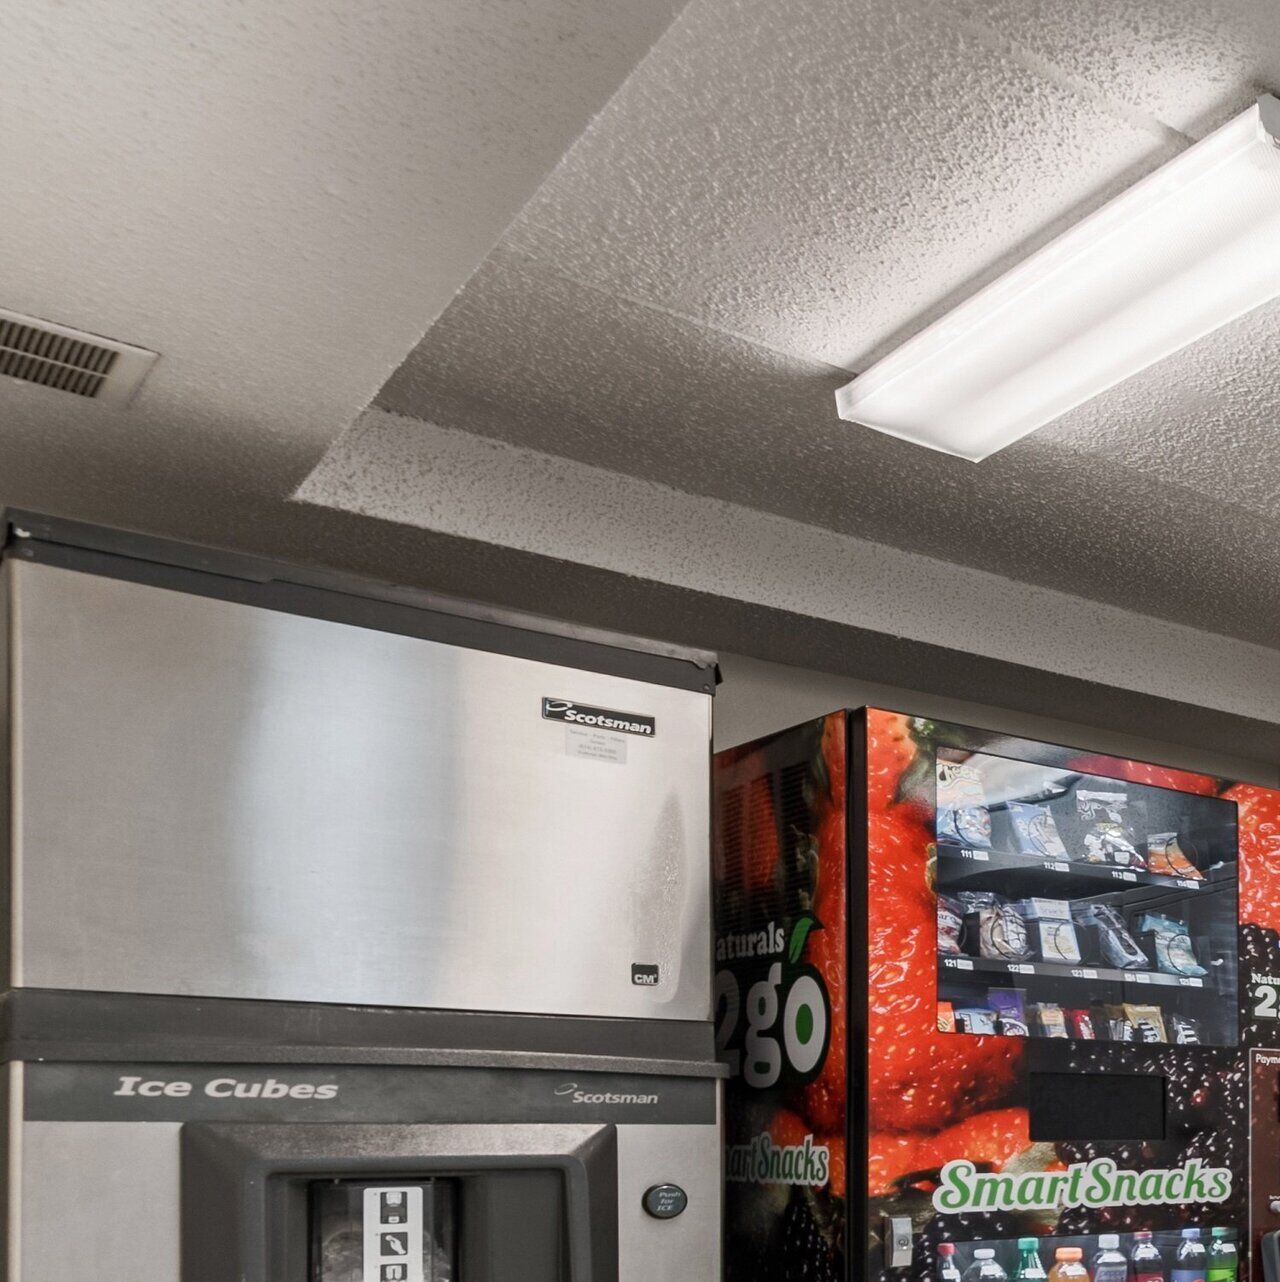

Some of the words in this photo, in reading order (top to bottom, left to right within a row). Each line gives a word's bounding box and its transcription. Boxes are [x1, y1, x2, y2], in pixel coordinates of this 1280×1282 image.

[564, 709, 653, 734] Scotsman
[961, 850, 972, 859] 111
[716, 921, 785, 962] aturals
[944, 959, 957, 967] 121
[1007, 964, 1019, 972] 122
[714, 962, 826, 1088] 2go
[113, 1076, 192, 1097] Ice
[204, 1078, 339, 1099] Cubes
[572, 1091, 658, 1104] Scotsman
[727, 1135, 829, 1183] artSnacks
[659, 1191, 681, 1199] Push
[937, 1159, 1230, 1211] SmartSnacks
